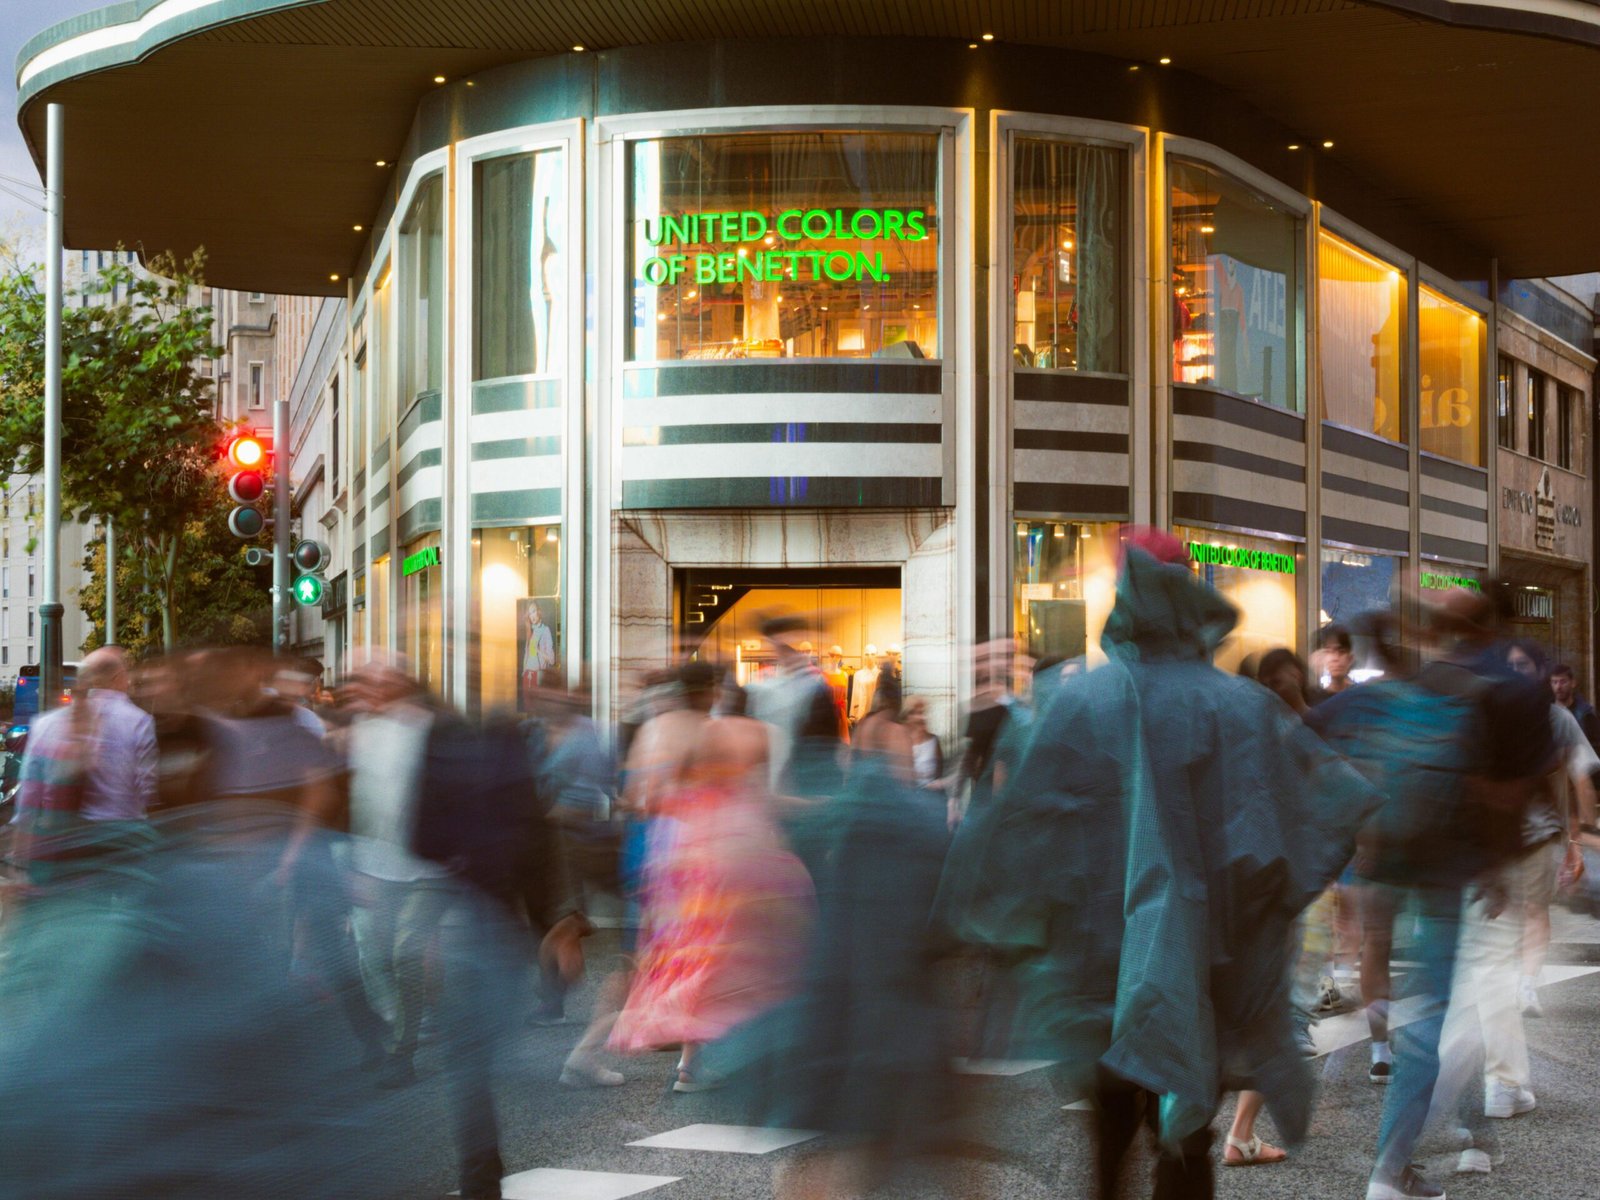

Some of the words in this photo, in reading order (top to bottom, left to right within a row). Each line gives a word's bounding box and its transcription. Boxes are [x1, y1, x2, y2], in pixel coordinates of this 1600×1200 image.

[644, 211, 768, 245] UNITED
[776, 208, 926, 241] COLORS
[641, 254, 687, 286] OF
[696, 250, 890, 284] BENETTON.
